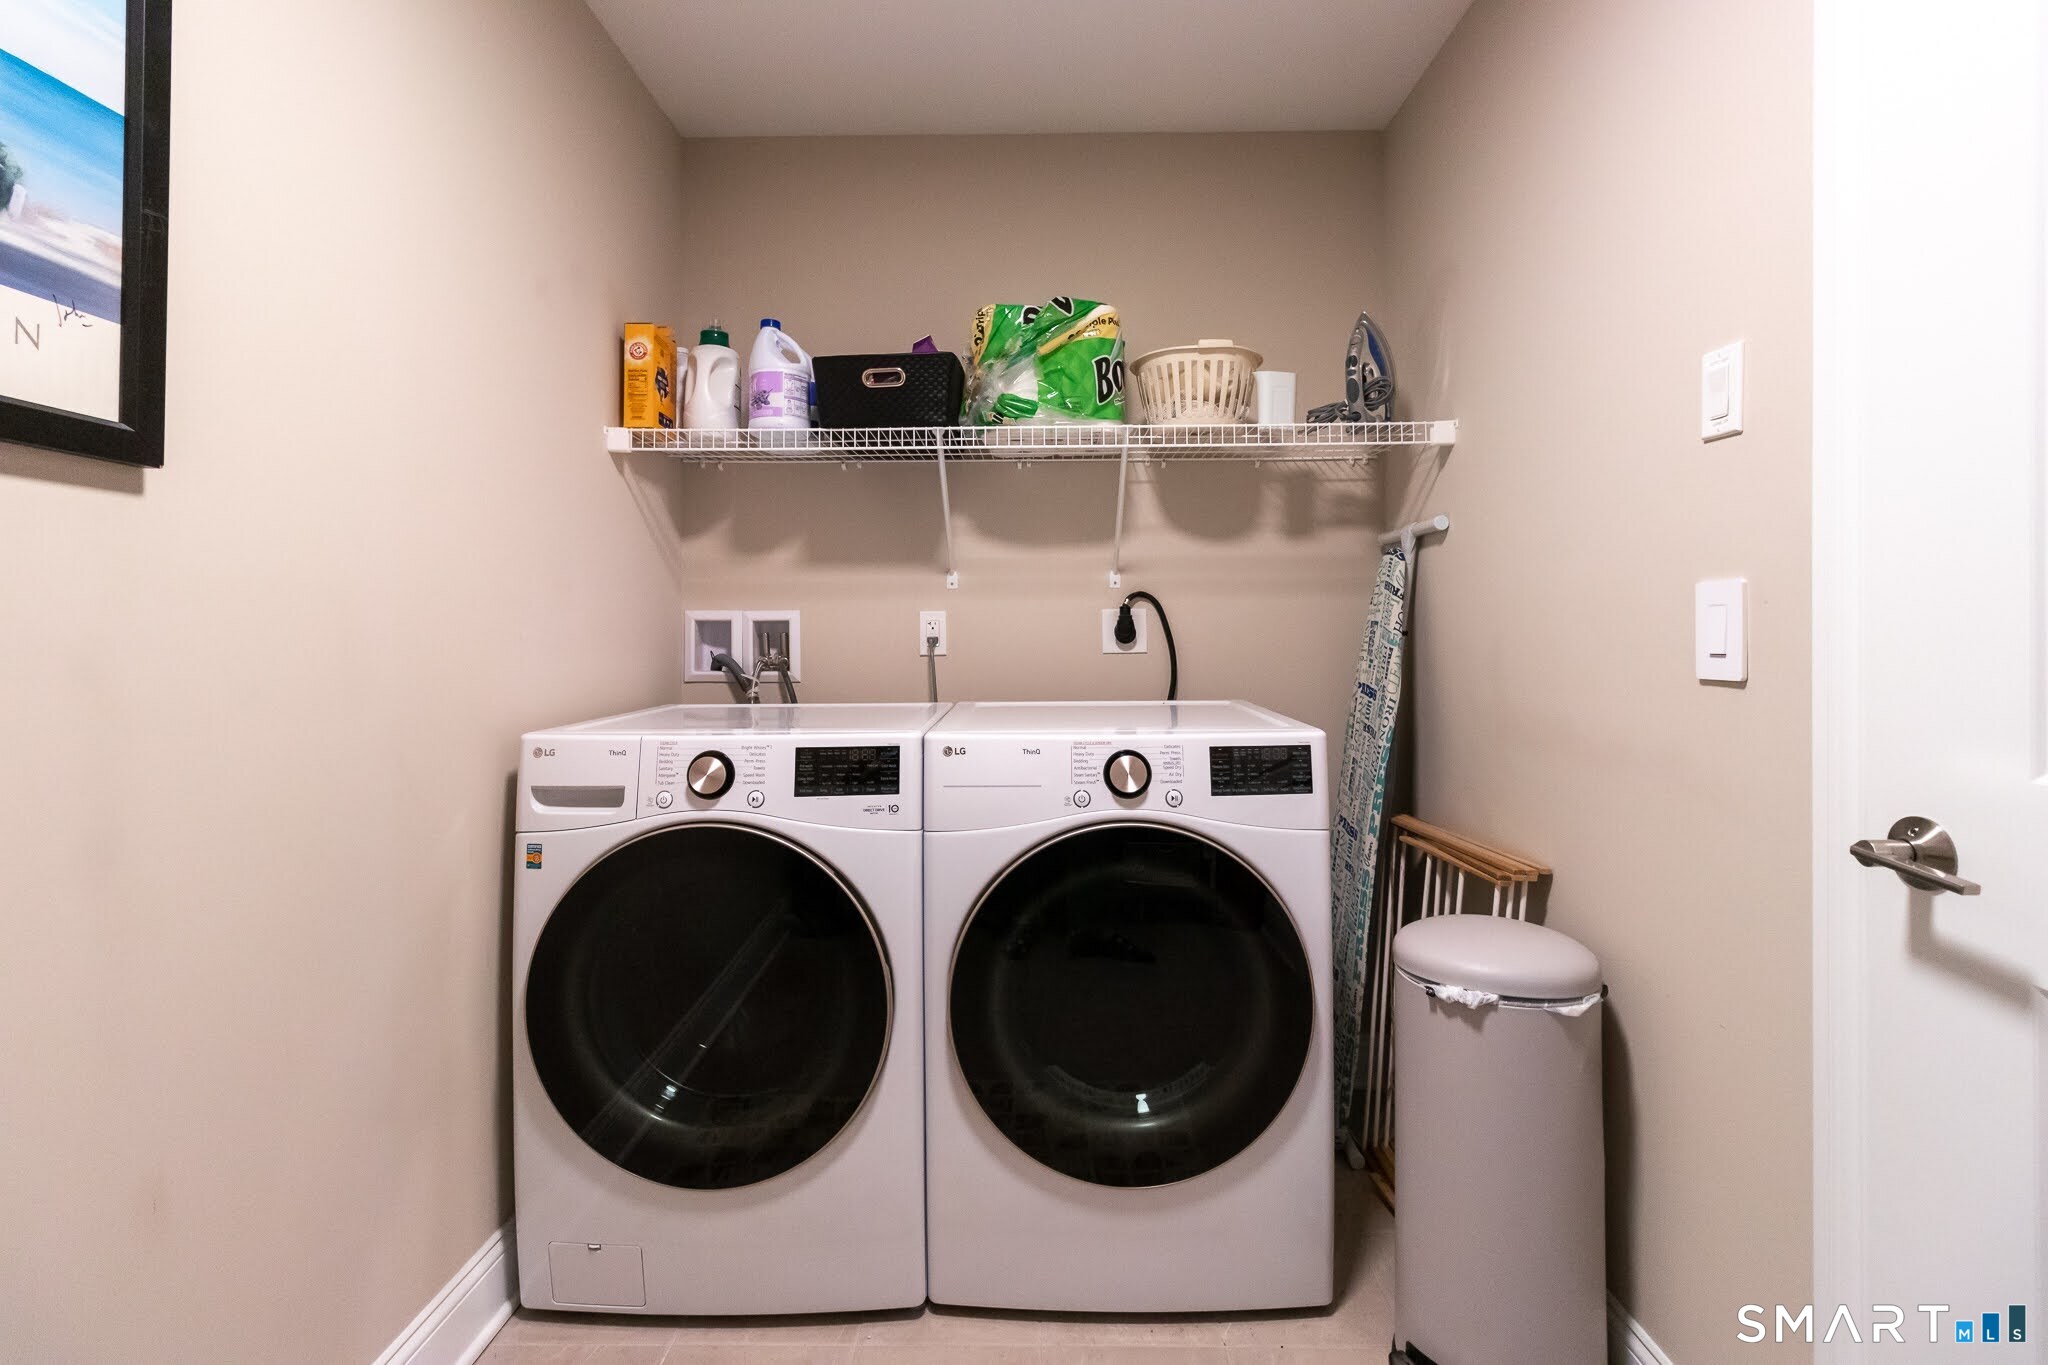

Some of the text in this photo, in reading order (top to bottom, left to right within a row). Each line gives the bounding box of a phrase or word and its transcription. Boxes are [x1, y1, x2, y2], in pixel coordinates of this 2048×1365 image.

[15, 316, 40, 351] N
[1378, 698, 1397, 742] IRON
[608, 749, 627, 757] ThinQ
